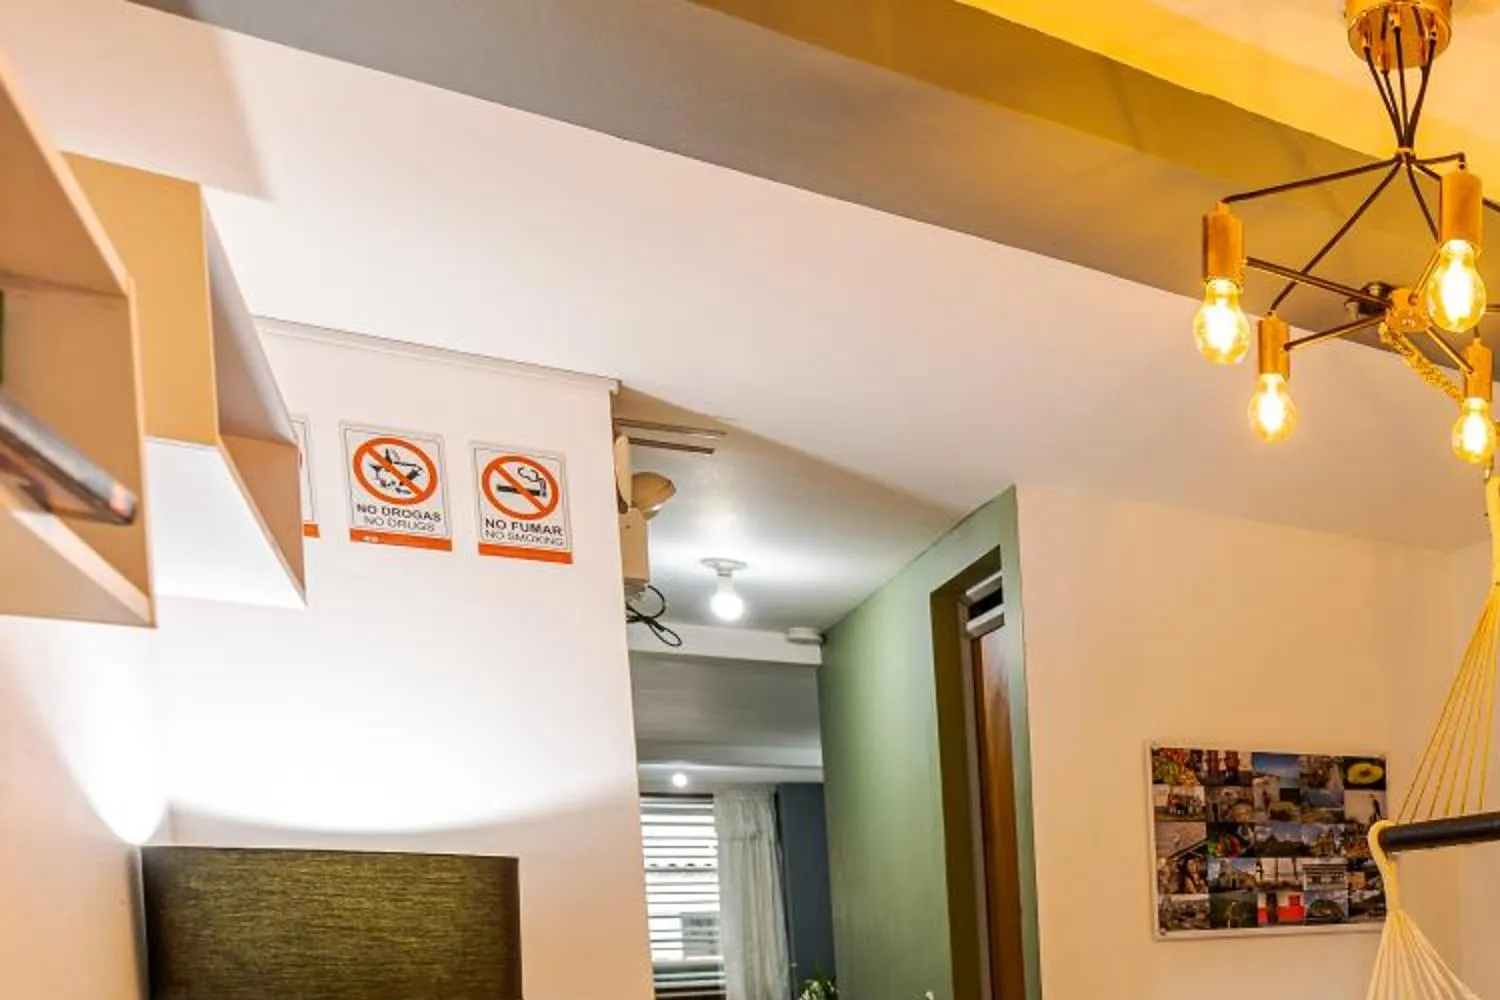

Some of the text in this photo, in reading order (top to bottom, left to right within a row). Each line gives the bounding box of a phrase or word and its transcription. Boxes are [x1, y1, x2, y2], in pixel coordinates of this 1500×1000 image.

[356, 503, 441, 523] NO DROGAS
[363, 515, 435, 532] NO DRUGS
[485, 518, 563, 537] NO FUMAR
[484, 529, 564, 546] NO SMOKING
